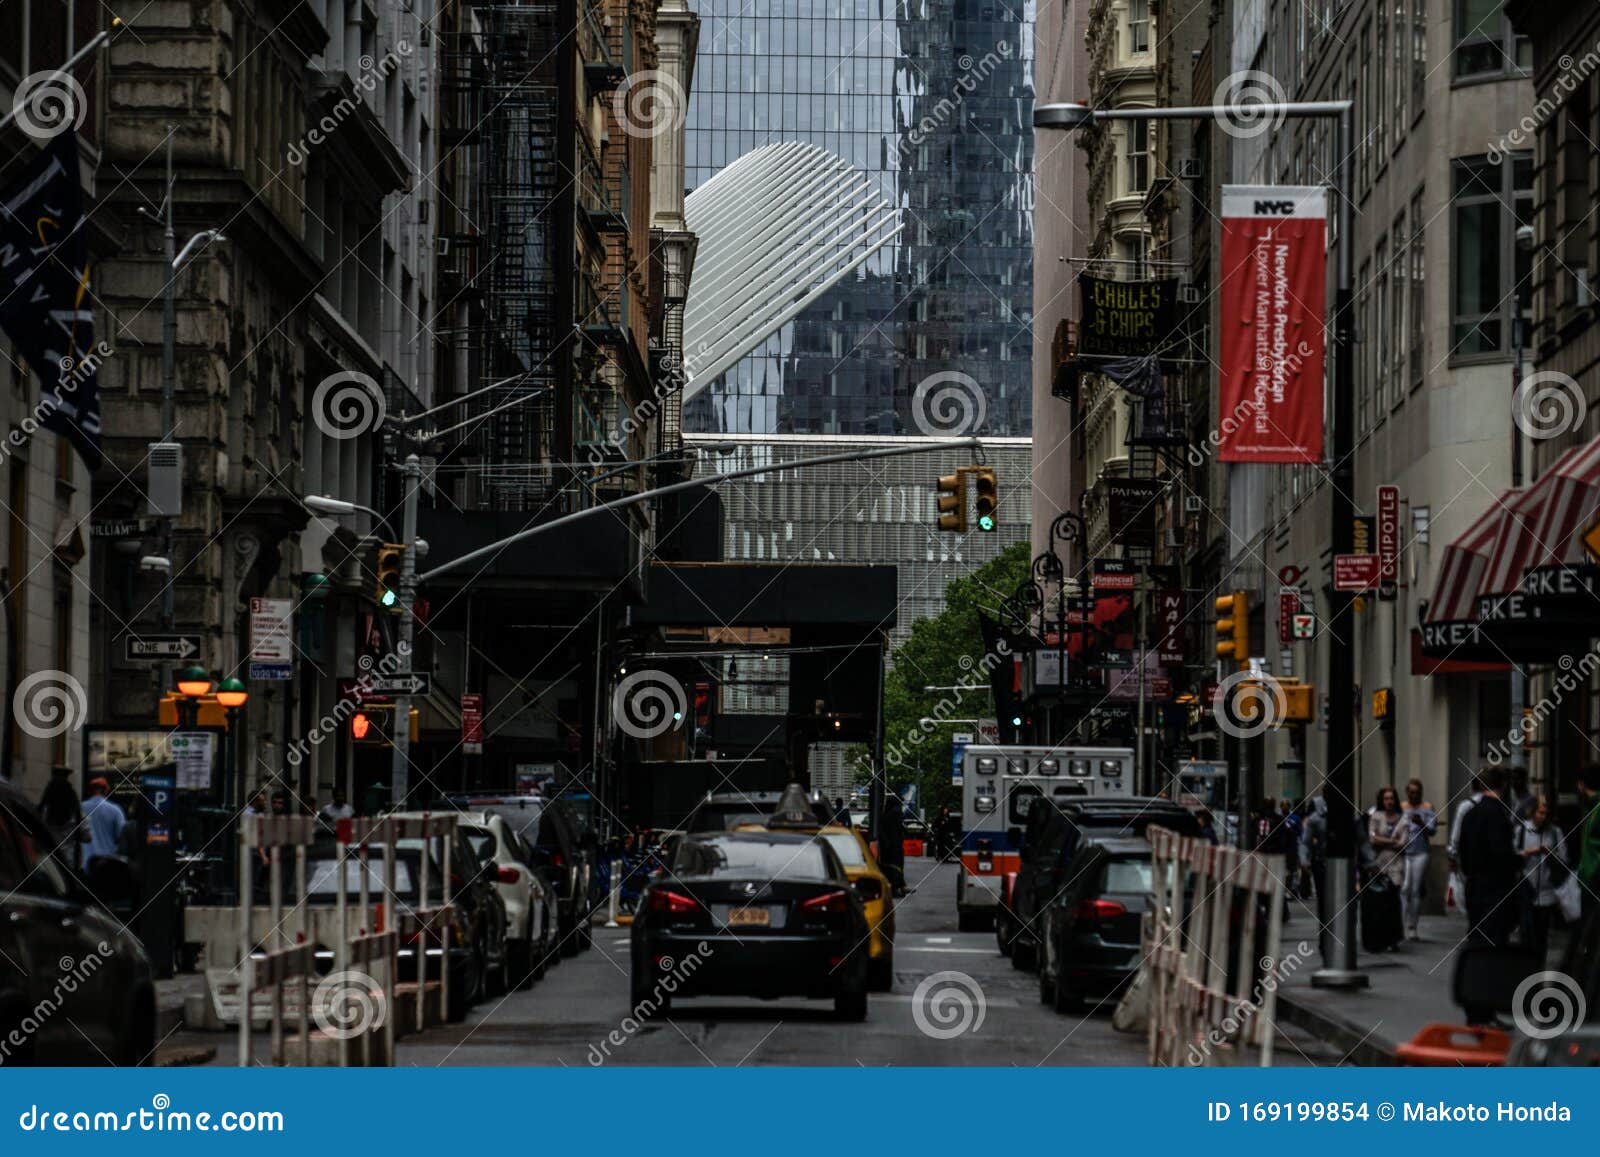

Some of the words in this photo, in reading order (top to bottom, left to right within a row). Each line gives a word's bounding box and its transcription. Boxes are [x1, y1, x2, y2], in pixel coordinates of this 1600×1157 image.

[1254, 201, 1294, 214] NYC
[1257, 244, 1271, 288] Lower
[1094, 280, 1160, 309] CABLES
[1109, 310, 1155, 337] CHIPS
[1256, 290, 1271, 371] Manhattan
[1254, 374, 1271, 434] Hospital
[1381, 490, 1395, 576] CHIPOTLE
[1104, 563, 1123, 571] NYC
[1093, 575, 1134, 586] financial
[137, 642, 158, 653] ONE
[168, 641, 190, 653] WAY
[378, 680, 394, 689] ONE
[401, 680, 419, 689] WAY
[155, 790, 168, 808] P
[976, 786, 996, 795] 1819
